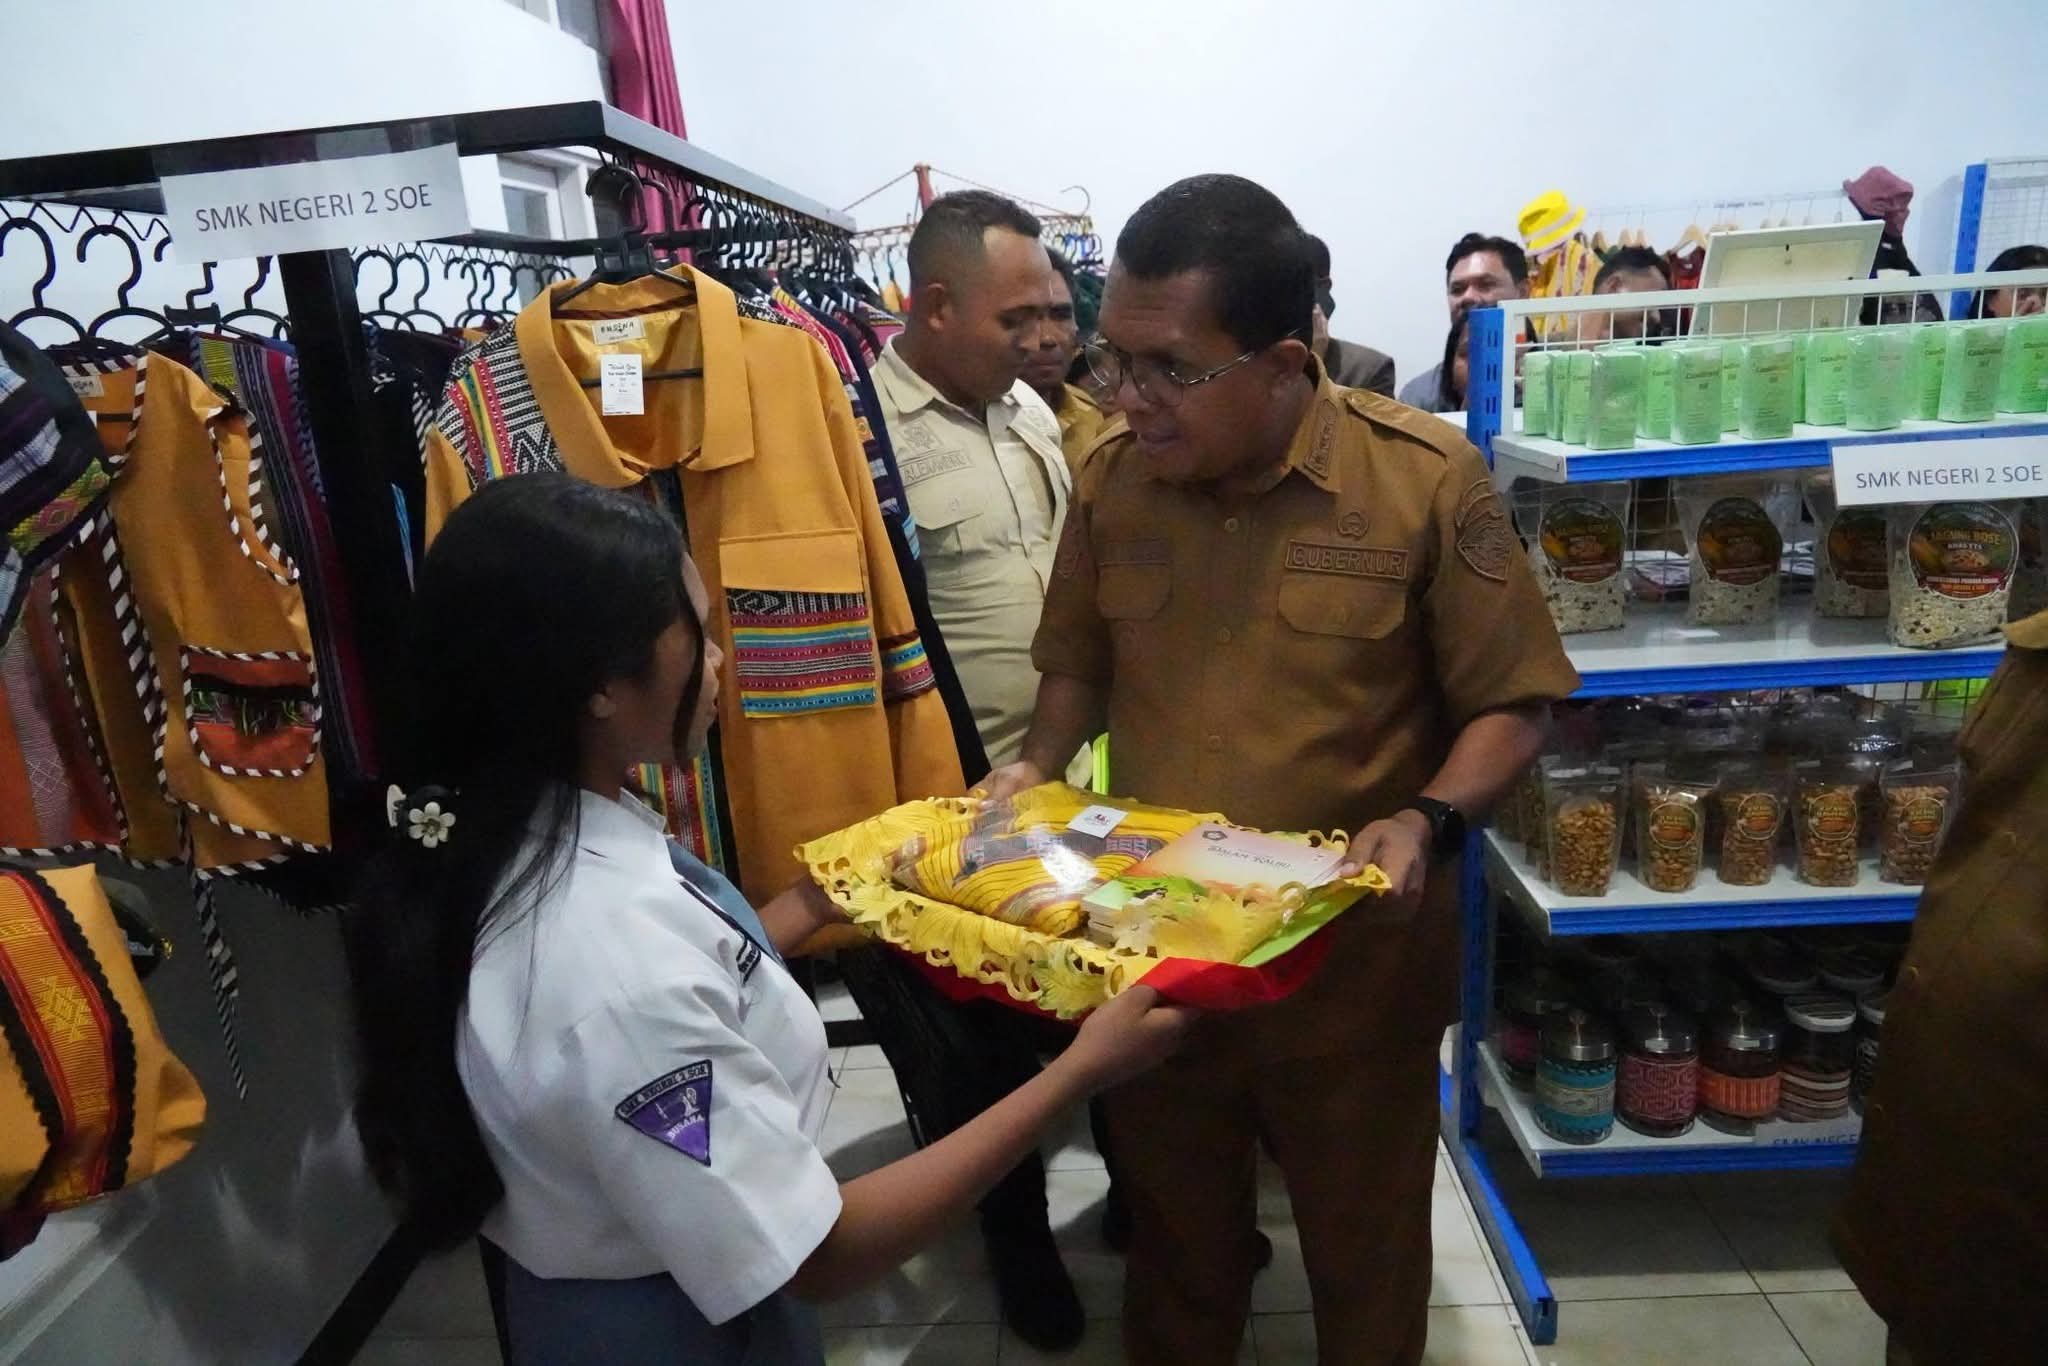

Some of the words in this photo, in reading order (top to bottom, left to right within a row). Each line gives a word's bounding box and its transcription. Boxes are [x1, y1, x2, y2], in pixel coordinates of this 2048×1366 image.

[195, 204, 252, 232] SMK
[259, 193, 354, 225] NEGERI
[362, 190, 378, 214] 2
[384, 183, 433, 212] SOE
[1856, 471, 1901, 489] SMK
[1907, 467, 1979, 486] NEGERI
[1986, 467, 1997, 484] 2
[2003, 464, 2043, 483] SOE
[1292, 547, 1402, 574] GUBERNUR
[666, 1113, 705, 1142] BUSANA
